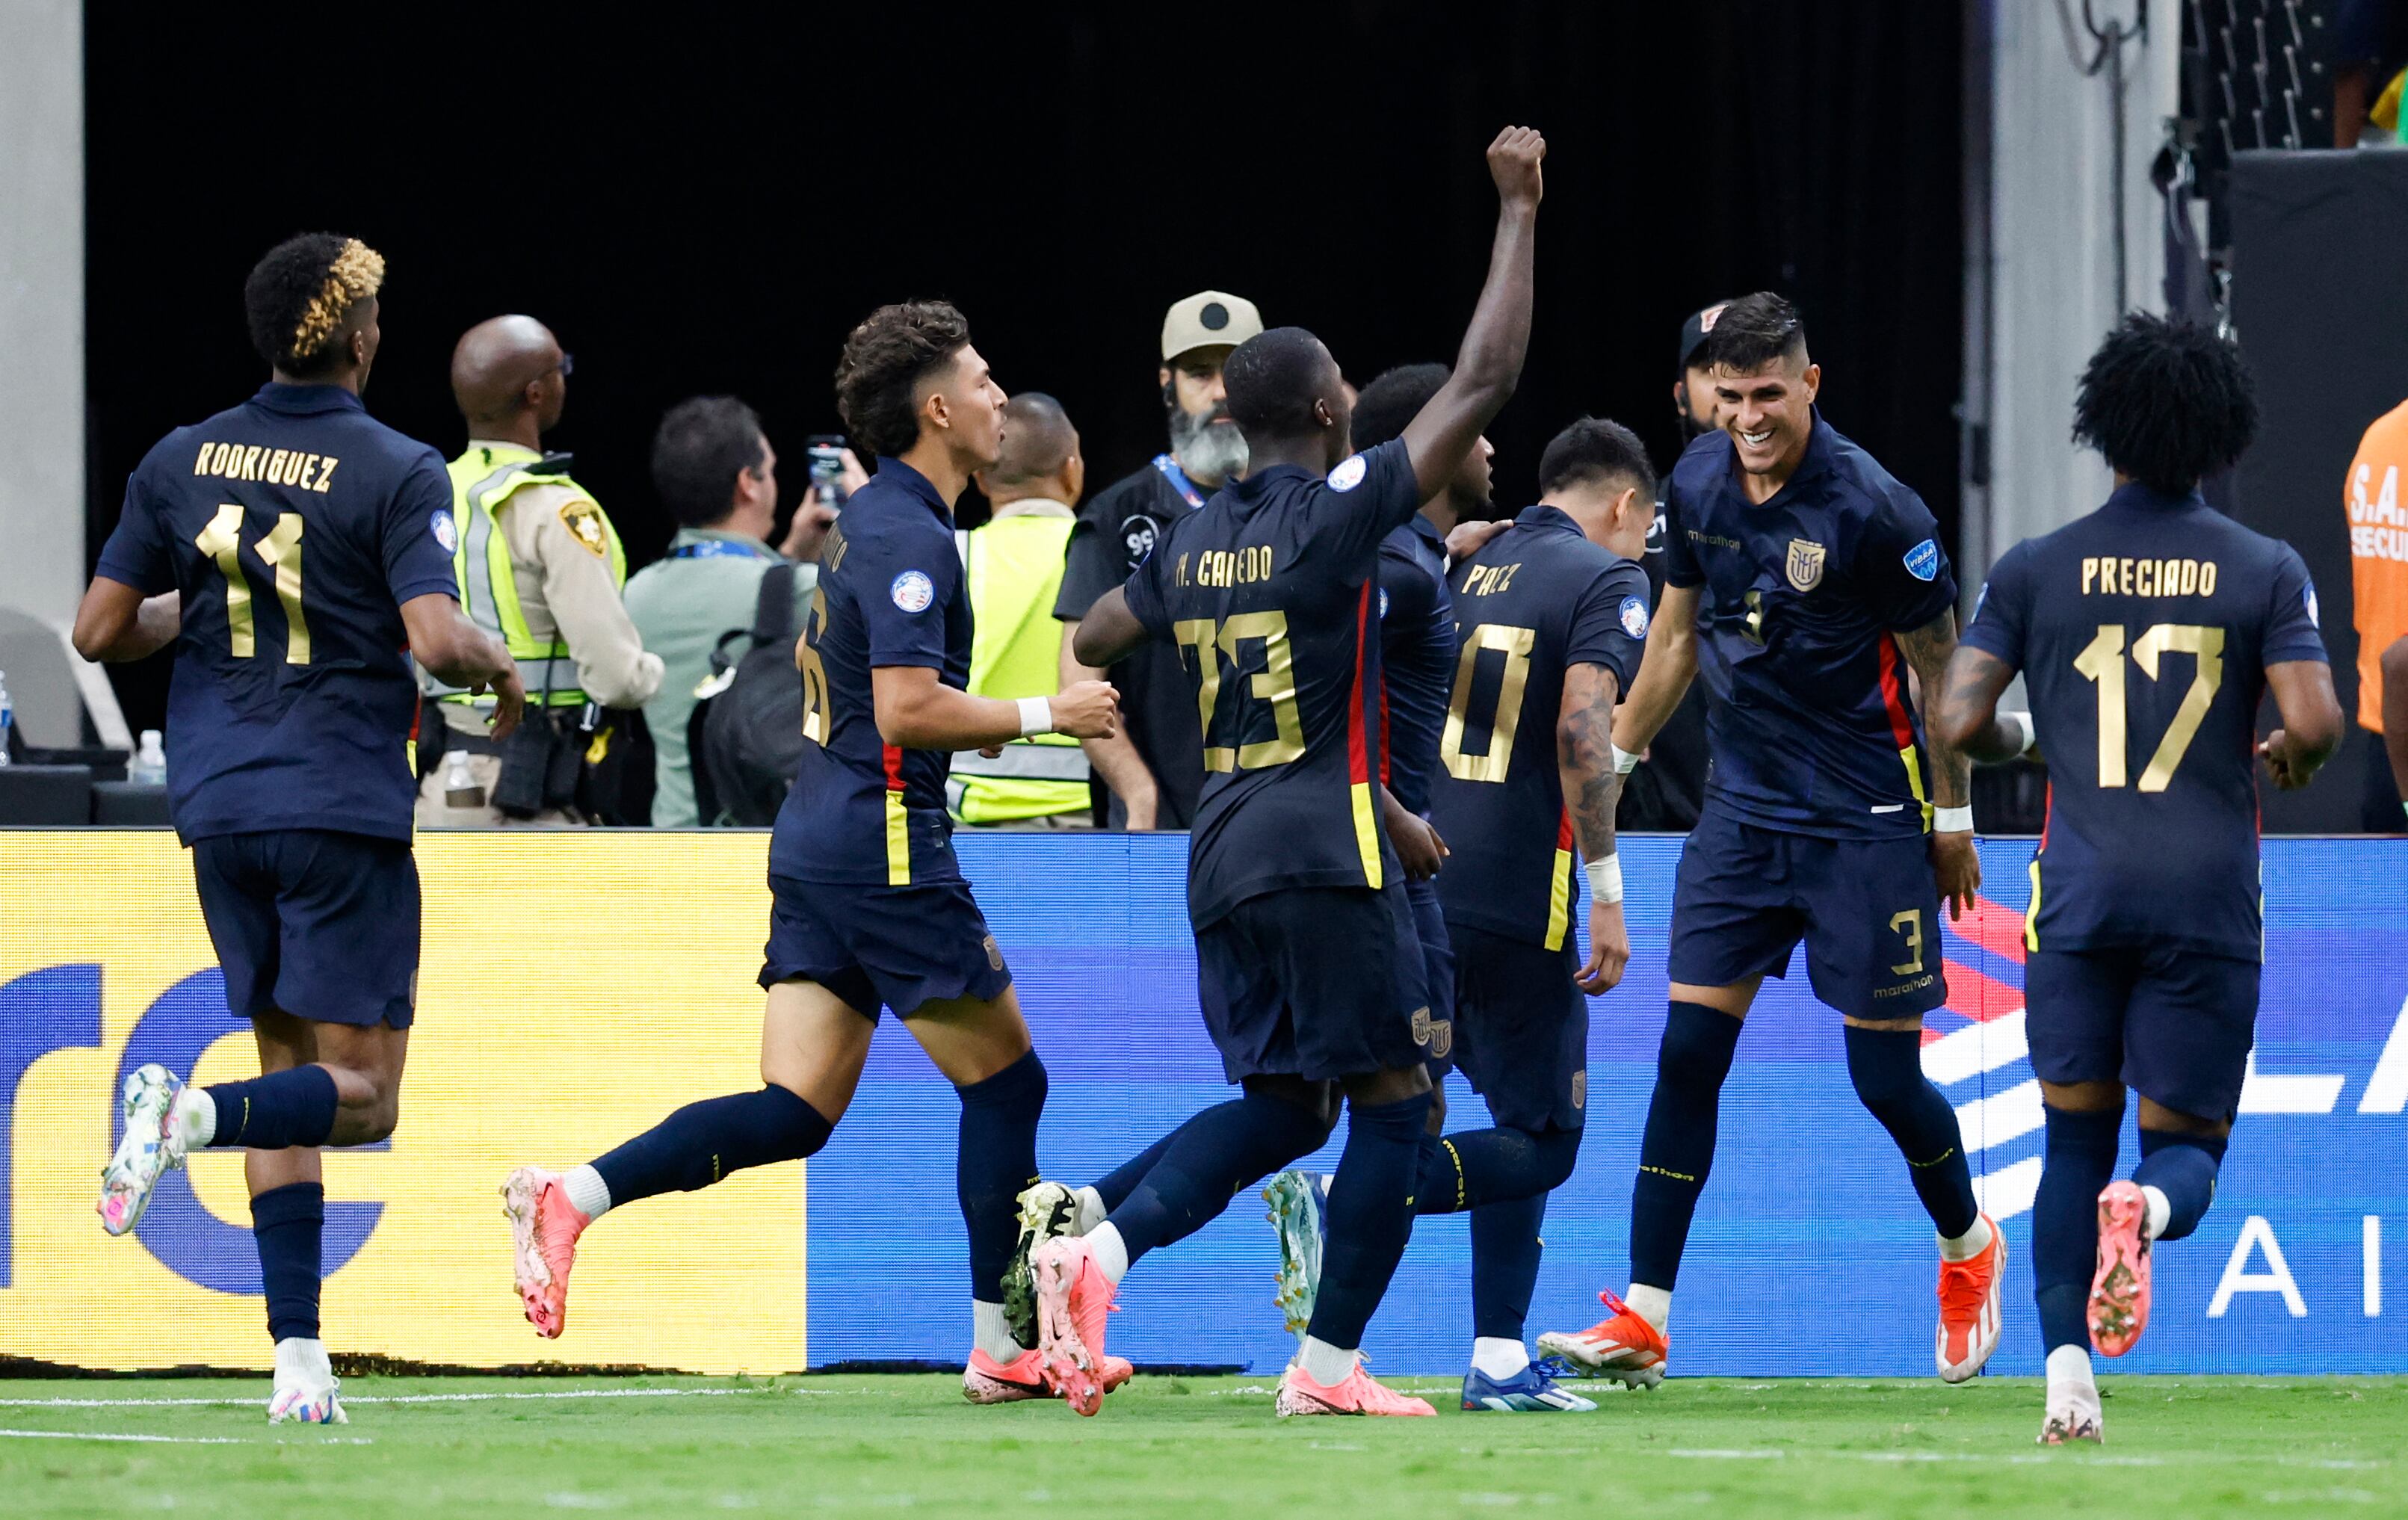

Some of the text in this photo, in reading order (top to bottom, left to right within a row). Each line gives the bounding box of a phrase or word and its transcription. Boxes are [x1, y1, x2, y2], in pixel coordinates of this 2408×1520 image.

[194, 442, 339, 493] RODRIGUEZ
[2350, 463, 2408, 527] S.A.
[1197, 546, 1273, 588] CAIEDO
[2350, 525, 2408, 563] SECU
[194, 504, 311, 665] 11
[2082, 557, 2217, 597] PRECIADO
[1441, 622, 1536, 783] 0
[2073, 623, 2226, 793] 17
[1889, 909, 1923, 975] 3
[1874, 974, 1934, 998] marathon
